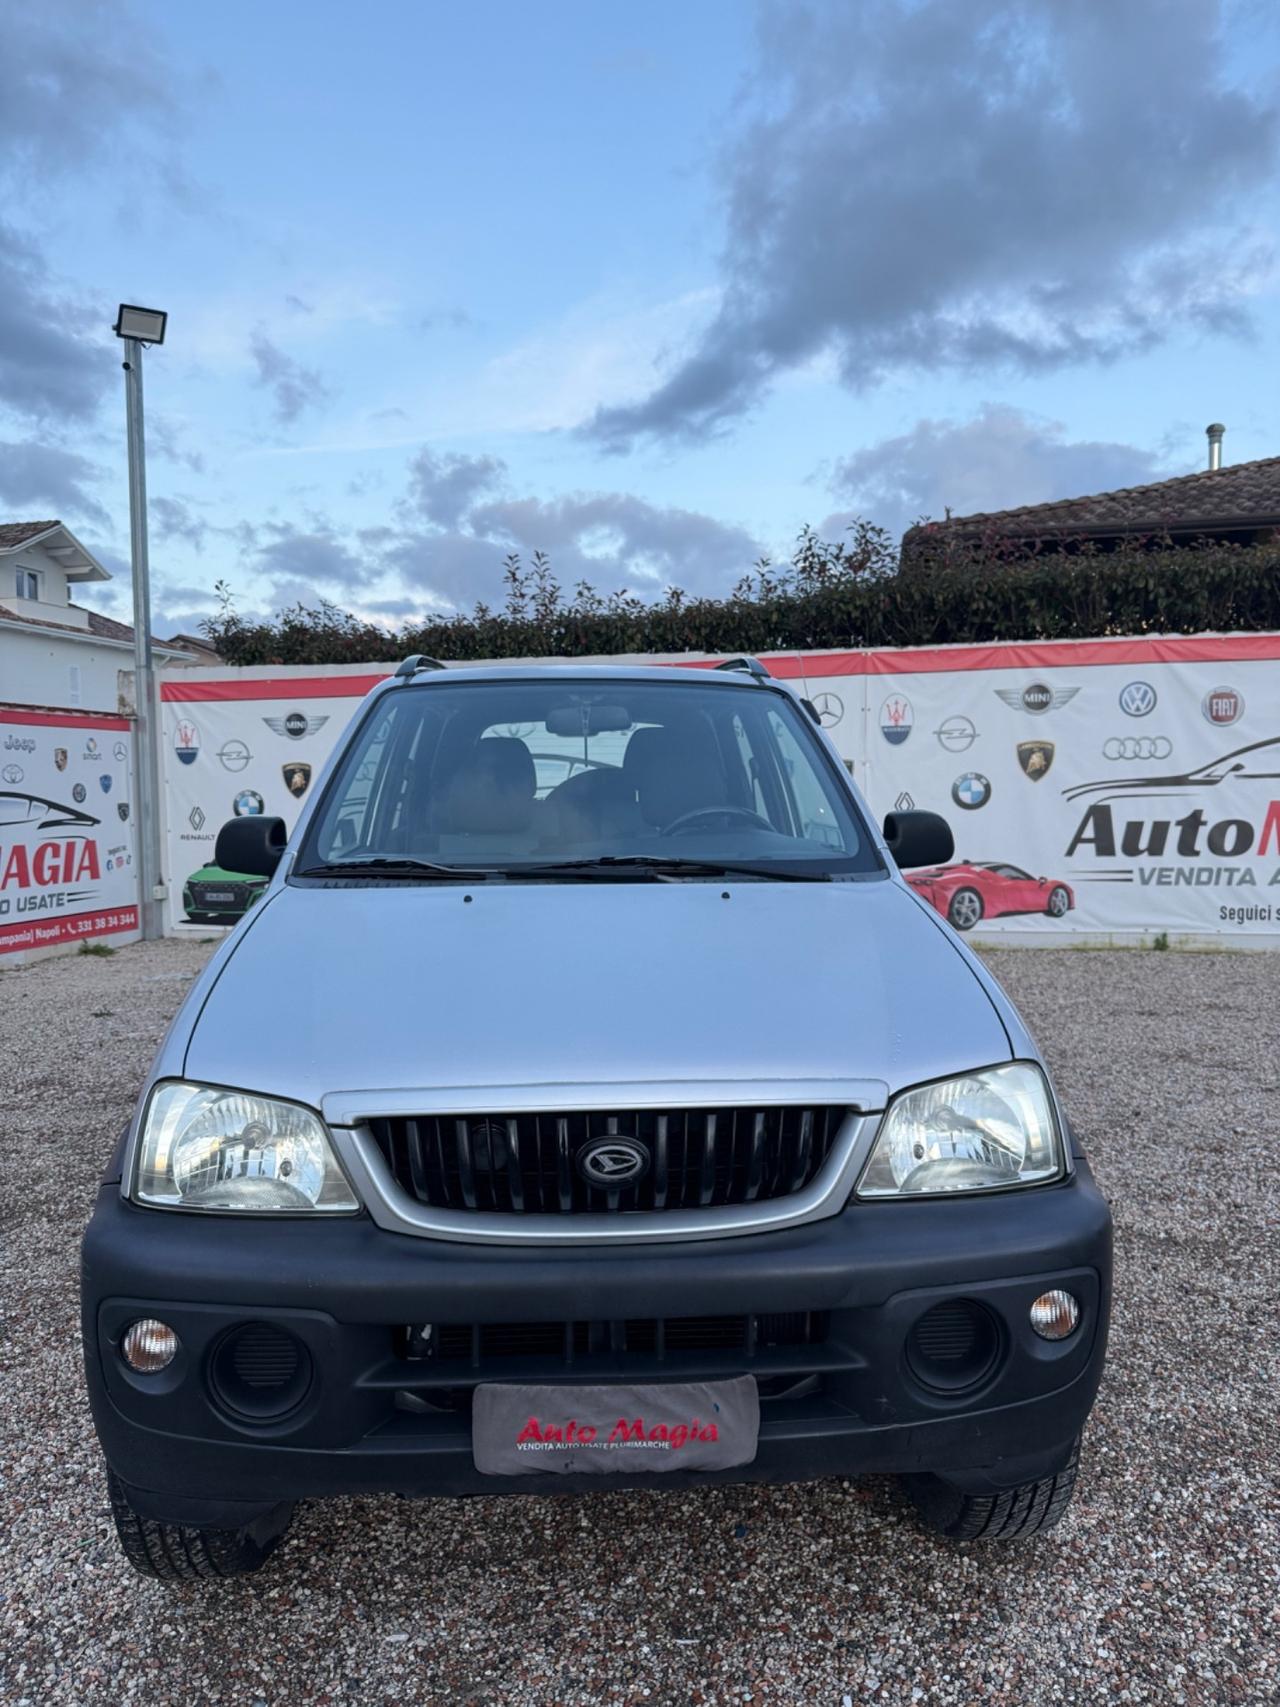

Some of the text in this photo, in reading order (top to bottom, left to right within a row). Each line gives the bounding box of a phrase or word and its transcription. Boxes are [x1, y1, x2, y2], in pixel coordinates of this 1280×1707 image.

[1025, 692, 1050, 703] MINI
[1212, 699, 1236, 716] FIAT
[4, 734, 36, 754] Jeep
[0, 839, 100, 891] AGIA
[1138, 867, 1257, 886] VENDITA
[17, 892, 65, 913] USATE
[1219, 904, 1272, 925] Seguici
[35, 925, 60, 940] Napoli
[78, 920, 92, 932] 331
[517, 1416, 719, 1449] Auto Magia
[516, 1442, 554, 1451] VENDITA
[555, 1442, 580, 1450] AUTO
[610, 1440, 670, 1450] PLURIMARCHE
